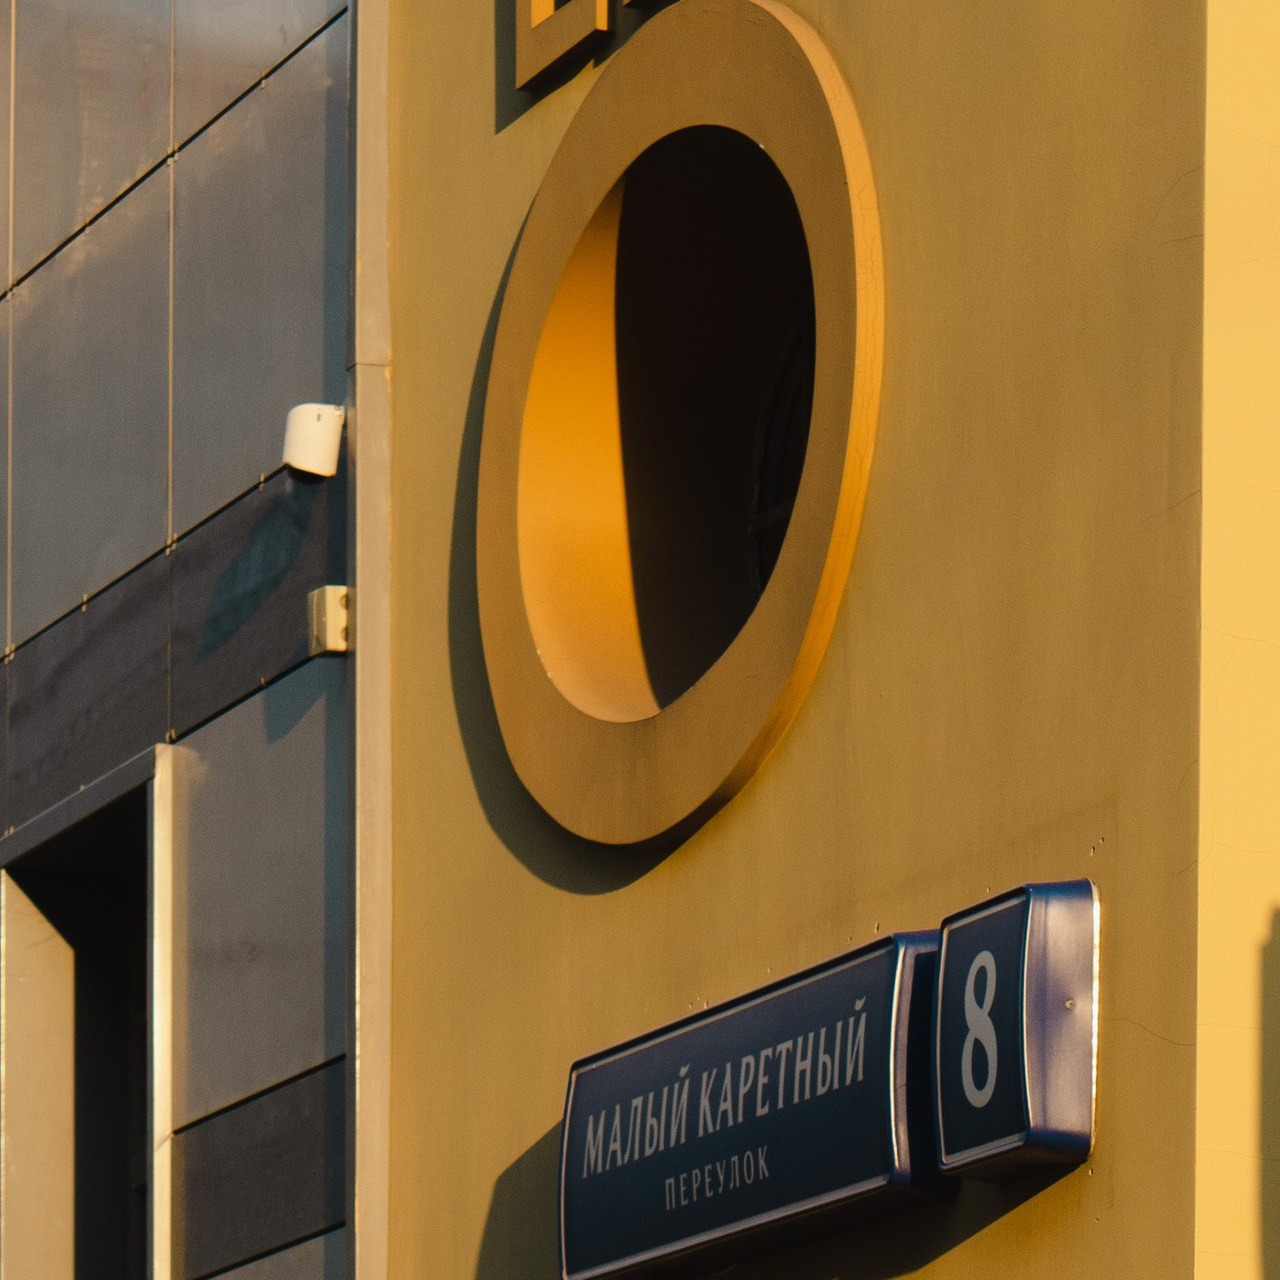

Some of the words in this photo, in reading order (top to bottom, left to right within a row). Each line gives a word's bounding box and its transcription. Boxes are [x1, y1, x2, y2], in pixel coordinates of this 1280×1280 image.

[582, 1063, 691, 1178] МАЛЫЙ
[697, 996, 867, 1138] КАРЕТНЫЙ
[961, 950, 997, 1108] 8
[664, 1146, 769, 1211] ПЕРЕУЛОК
